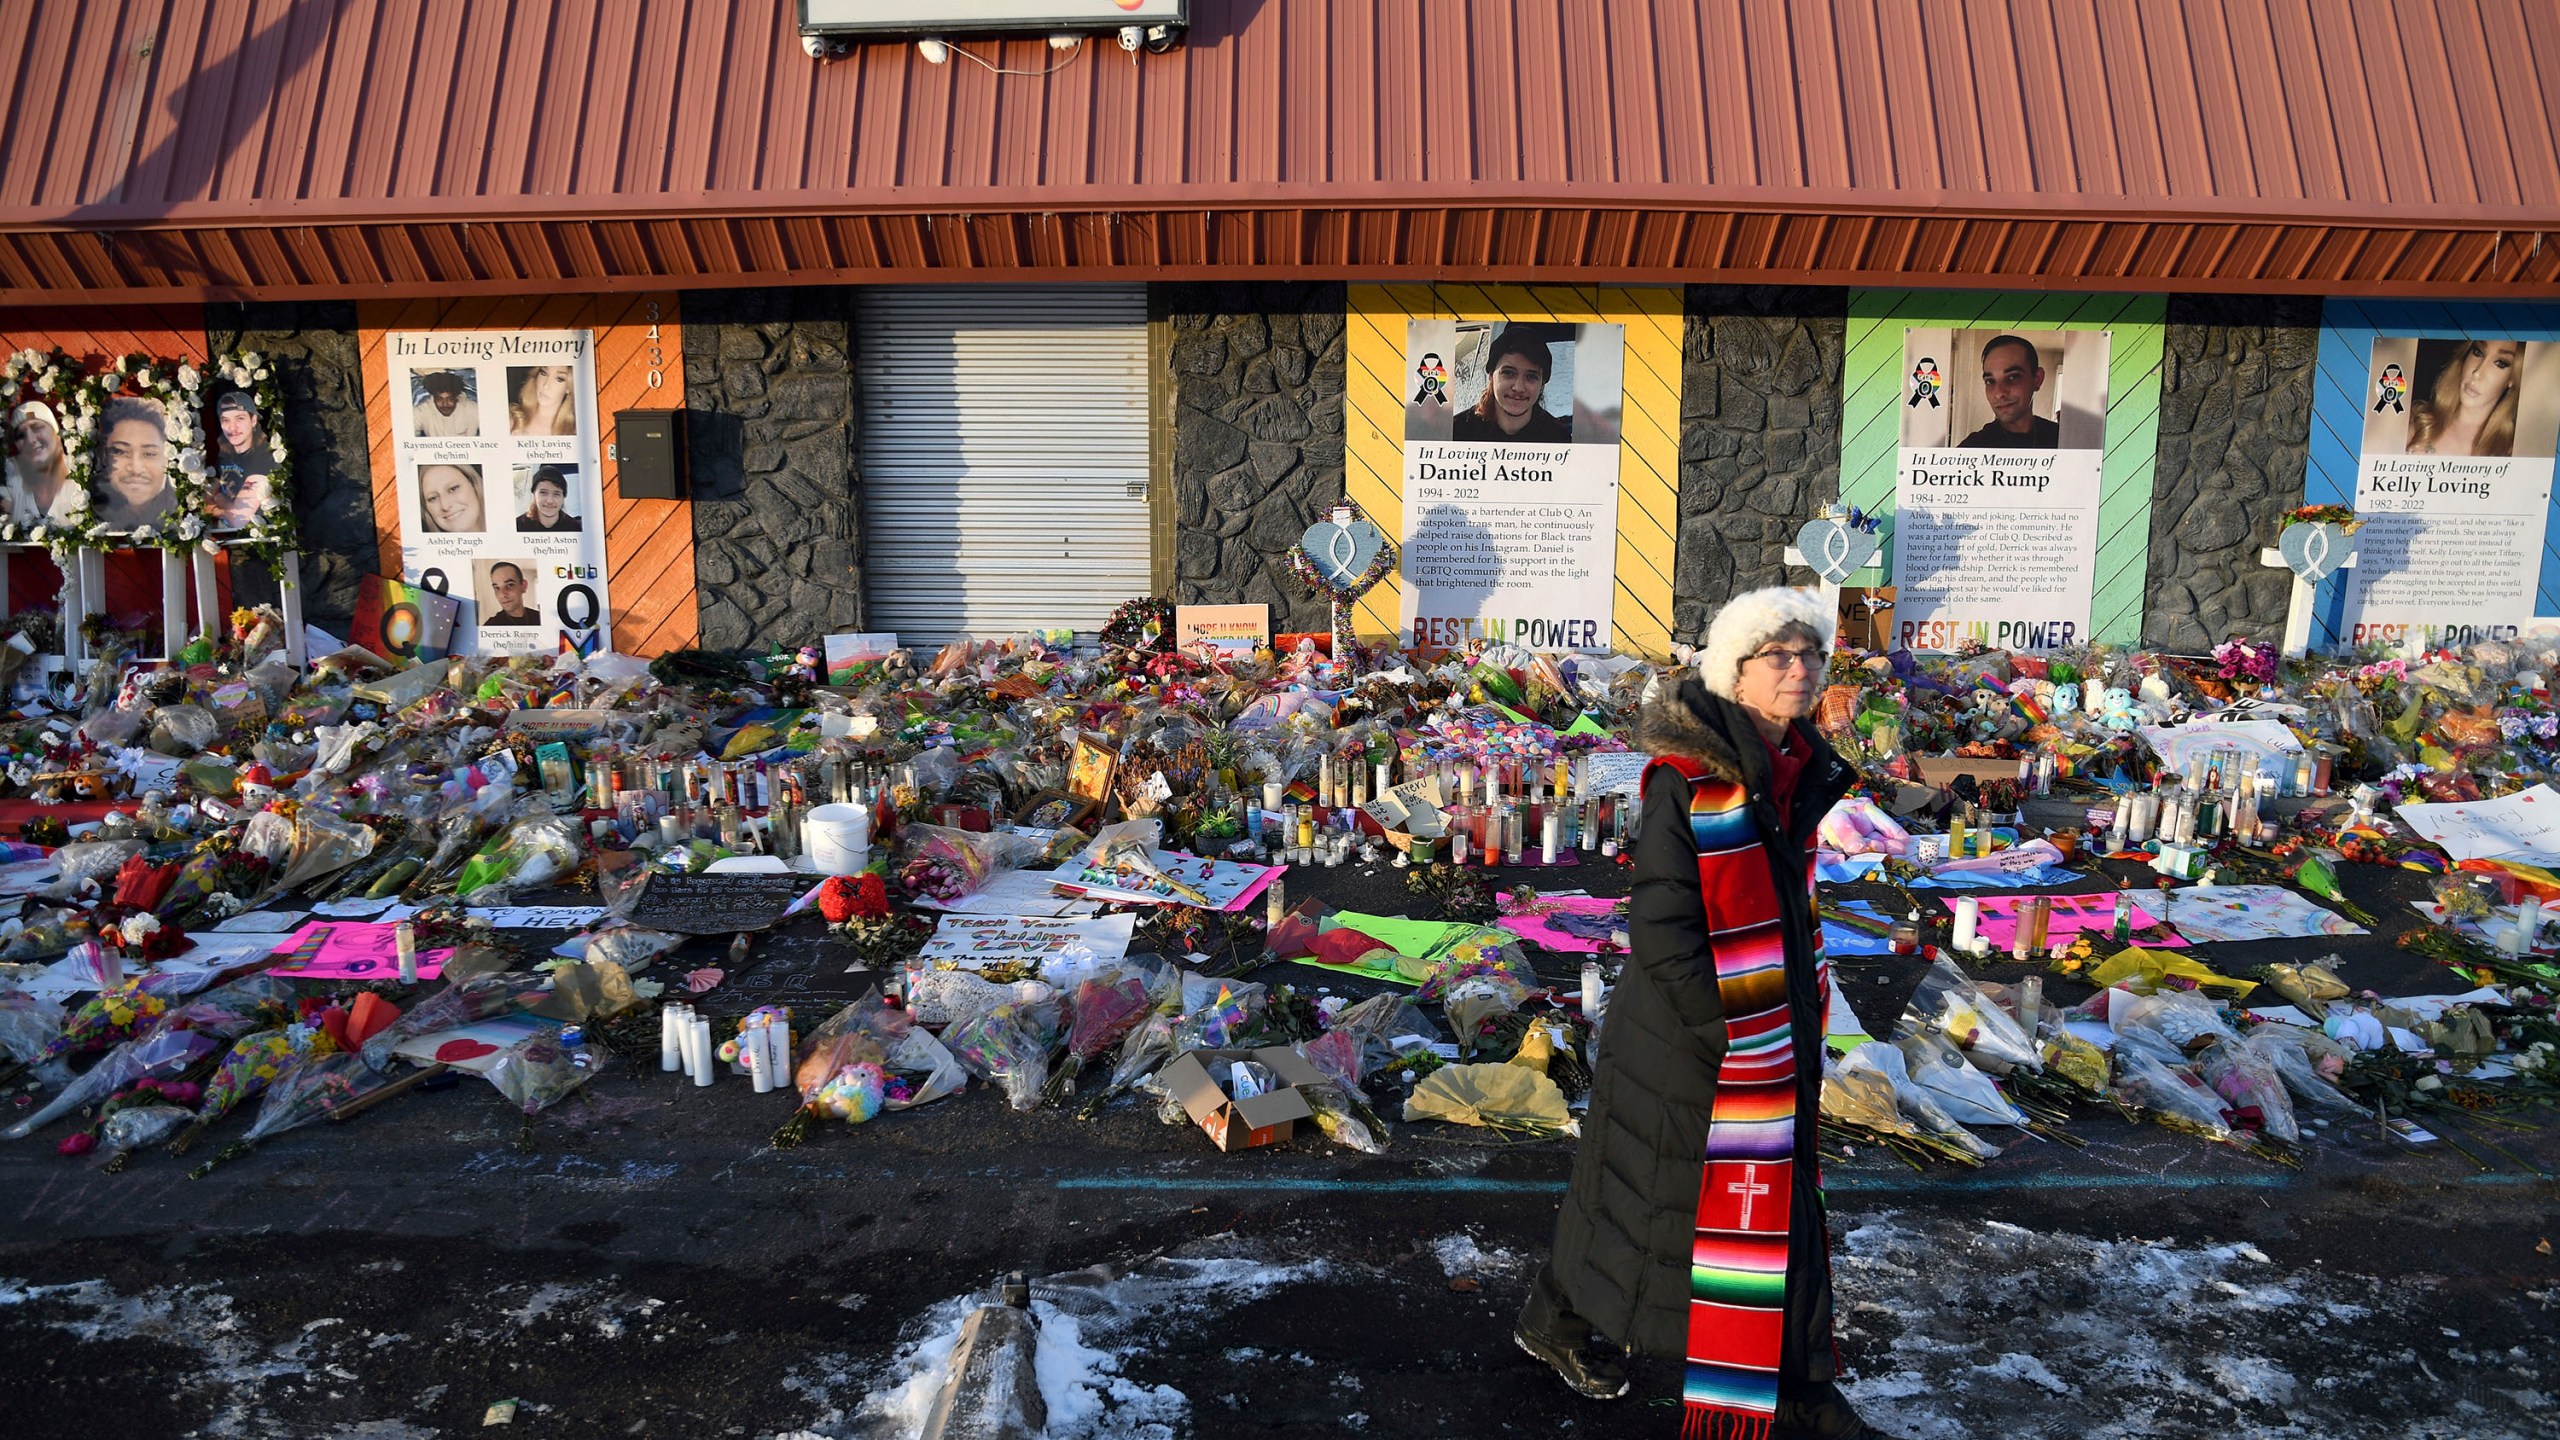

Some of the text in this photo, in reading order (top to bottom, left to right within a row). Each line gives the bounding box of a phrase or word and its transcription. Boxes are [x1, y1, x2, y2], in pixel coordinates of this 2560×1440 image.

[397, 336, 586, 360] In Loving Memory
[404, 441, 443, 451] Raymond
[517, 440, 572, 450] Kelly Loving
[434, 452, 469, 460] (he/him)
[527, 451, 563, 459] (she/her)
[1419, 447, 1570, 465] In Loving Memory of
[1913, 454, 2057, 470] In Loving Memory of
[1420, 463, 1552, 481] Daniel Aston
[2373, 460, 2510, 478] In Loving Memory of
[1912, 470, 2049, 492] Derrick Rump
[2371, 476, 2490, 499] Kelly Loving
[1418, 488, 1443, 497] 1994
[1454, 488, 1479, 498] 2022
[1911, 494, 1933, 503] 1984
[1944, 494, 1968, 503] 2022
[2370, 499, 2392, 509] 1982
[2401, 500, 2424, 509] 2022
[1418, 505, 1447, 515] Daniel
[1451, 507, 1469, 517] was
[1480, 507, 1525, 516] bartender
[1539, 508, 1562, 517] Club
[1564, 509, 1574, 518] Q.
[1909, 511, 1940, 523] Always
[1941, 512, 1970, 523] bubbly
[1417, 518, 1467, 531] outspoken
[1469, 521, 1492, 529] trans
[1521, 520, 1532, 528] he
[1534, 521, 1594, 533] continuously
[2366, 517, 2385, 525] Kelly
[428, 537, 483, 547] Ashley Paugh
[523, 536, 551, 544] Daniel
[1416, 530, 1448, 543] helped
[1476, 531, 1522, 541] donations
[1525, 532, 1538, 540] for
[1541, 532, 1565, 541] Black
[438, 548, 473, 556] (she/her)
[533, 547, 568, 555] (he/him)
[1416, 542, 1448, 553] people
[1465, 543, 1478, 551] his
[1481, 542, 1530, 556] Instagram.
[1534, 544, 1563, 553] Daniel
[1567, 545, 1574, 553] is
[1416, 554, 1475, 563] remembered
[1477, 555, 1492, 563] for
[1494, 555, 1507, 565] his
[1510, 558, 1546, 567] support
[557, 563, 598, 579] club
[1416, 566, 1451, 576] LGBTQ
[1453, 567, 1507, 579] community
[1510, 568, 1527, 576] and
[1551, 568, 1565, 576] the
[1568, 568, 1589, 579] light
[1415, 578, 1433, 586] that
[1437, 578, 1487, 589] brightened
[1490, 579, 1504, 587] the
[557, 583, 600, 630] Q
[514, 631, 539, 640] Rump
[1413, 617, 1598, 647] REST IN POWER
[1901, 620, 2076, 650] REST IN POWER
[493, 641, 527, 651] (he/him)
